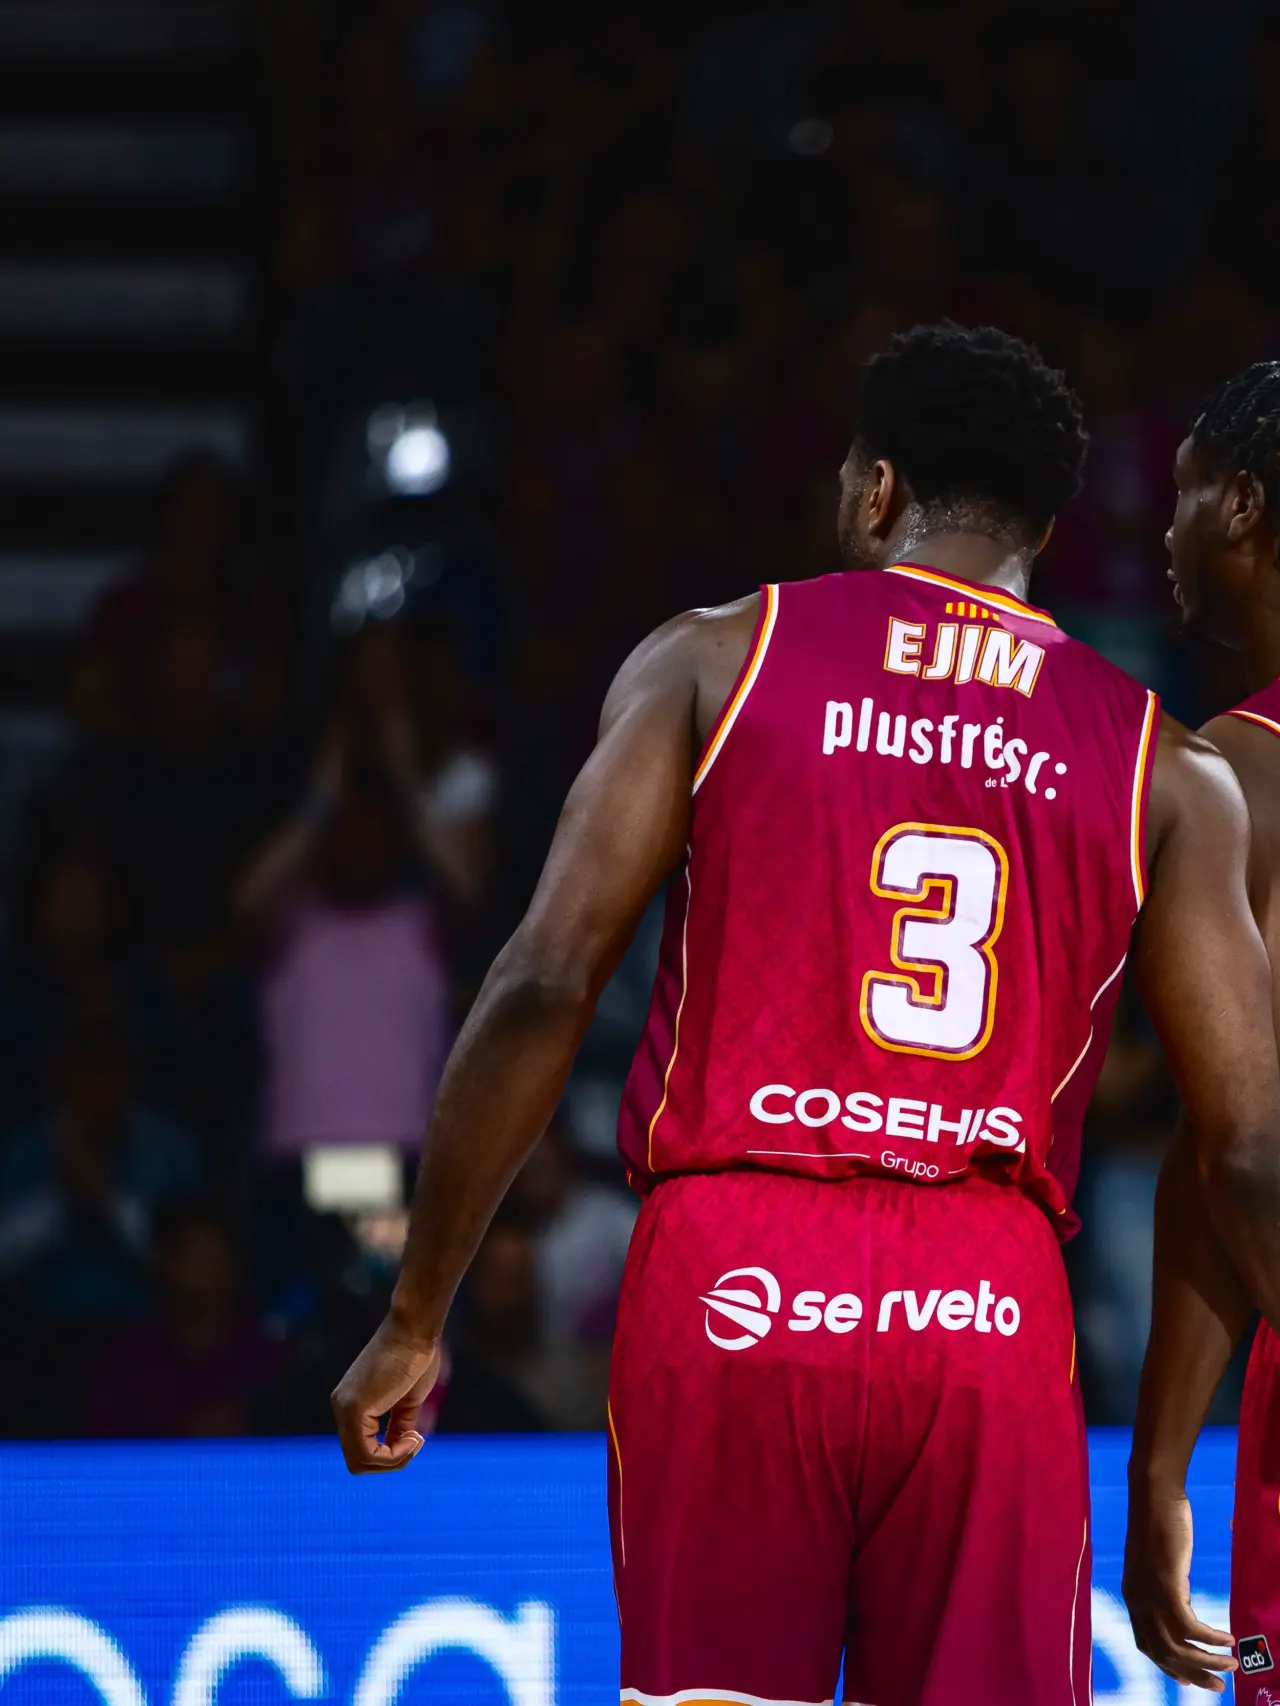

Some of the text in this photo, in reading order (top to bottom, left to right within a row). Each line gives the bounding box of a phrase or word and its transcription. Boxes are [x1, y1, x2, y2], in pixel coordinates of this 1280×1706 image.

[884, 616, 1045, 698] EJIM
[985, 777, 997, 788] de
[860, 821, 1009, 1061] 3
[749, 1084, 1027, 1154] COSEHIS
[880, 1150, 939, 1179] Grupo
[1243, 1651, 1265, 1668] acb
